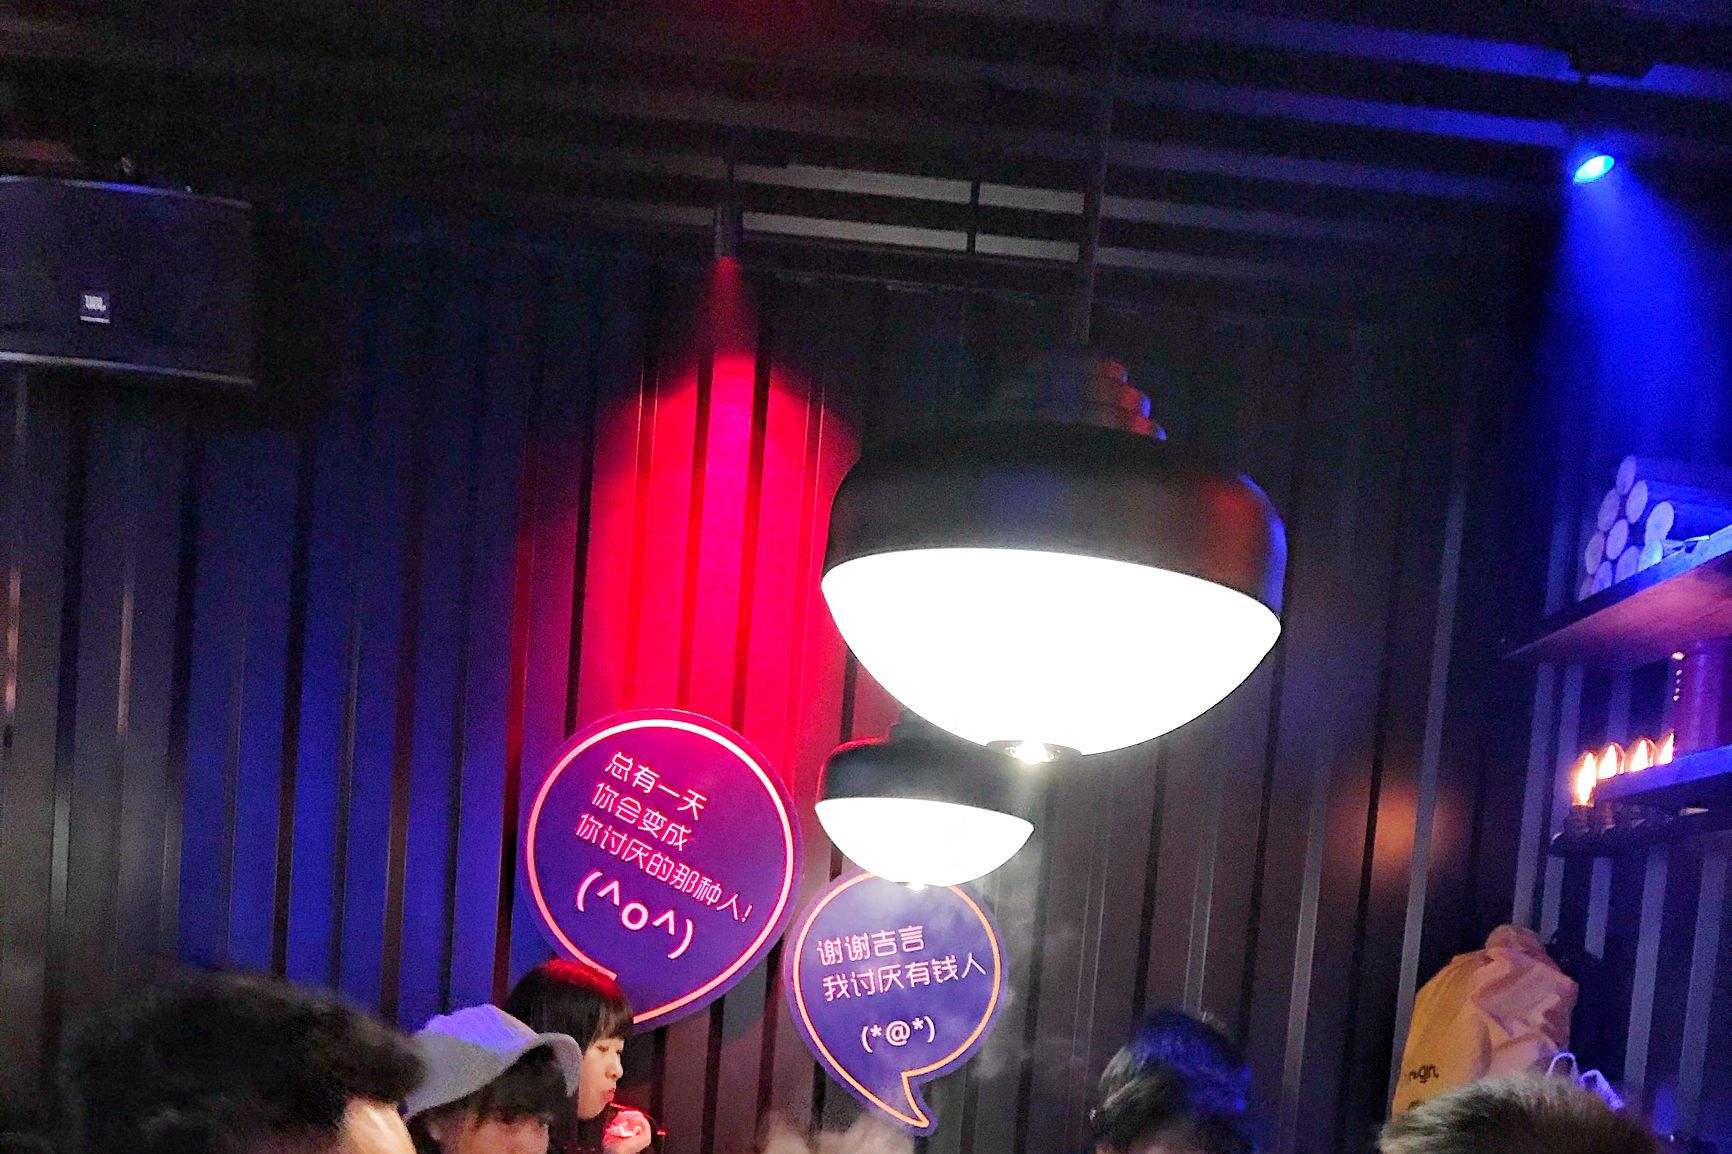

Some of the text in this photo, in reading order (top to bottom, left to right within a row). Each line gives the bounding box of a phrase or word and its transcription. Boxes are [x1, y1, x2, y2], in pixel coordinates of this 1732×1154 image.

[604, 751, 707, 821] 总有一天
[591, 782, 692, 851] 你会变成
[816, 925, 925, 966] 谢谢吉言
[822, 951, 987, 1002] 我讨厌有钱人
